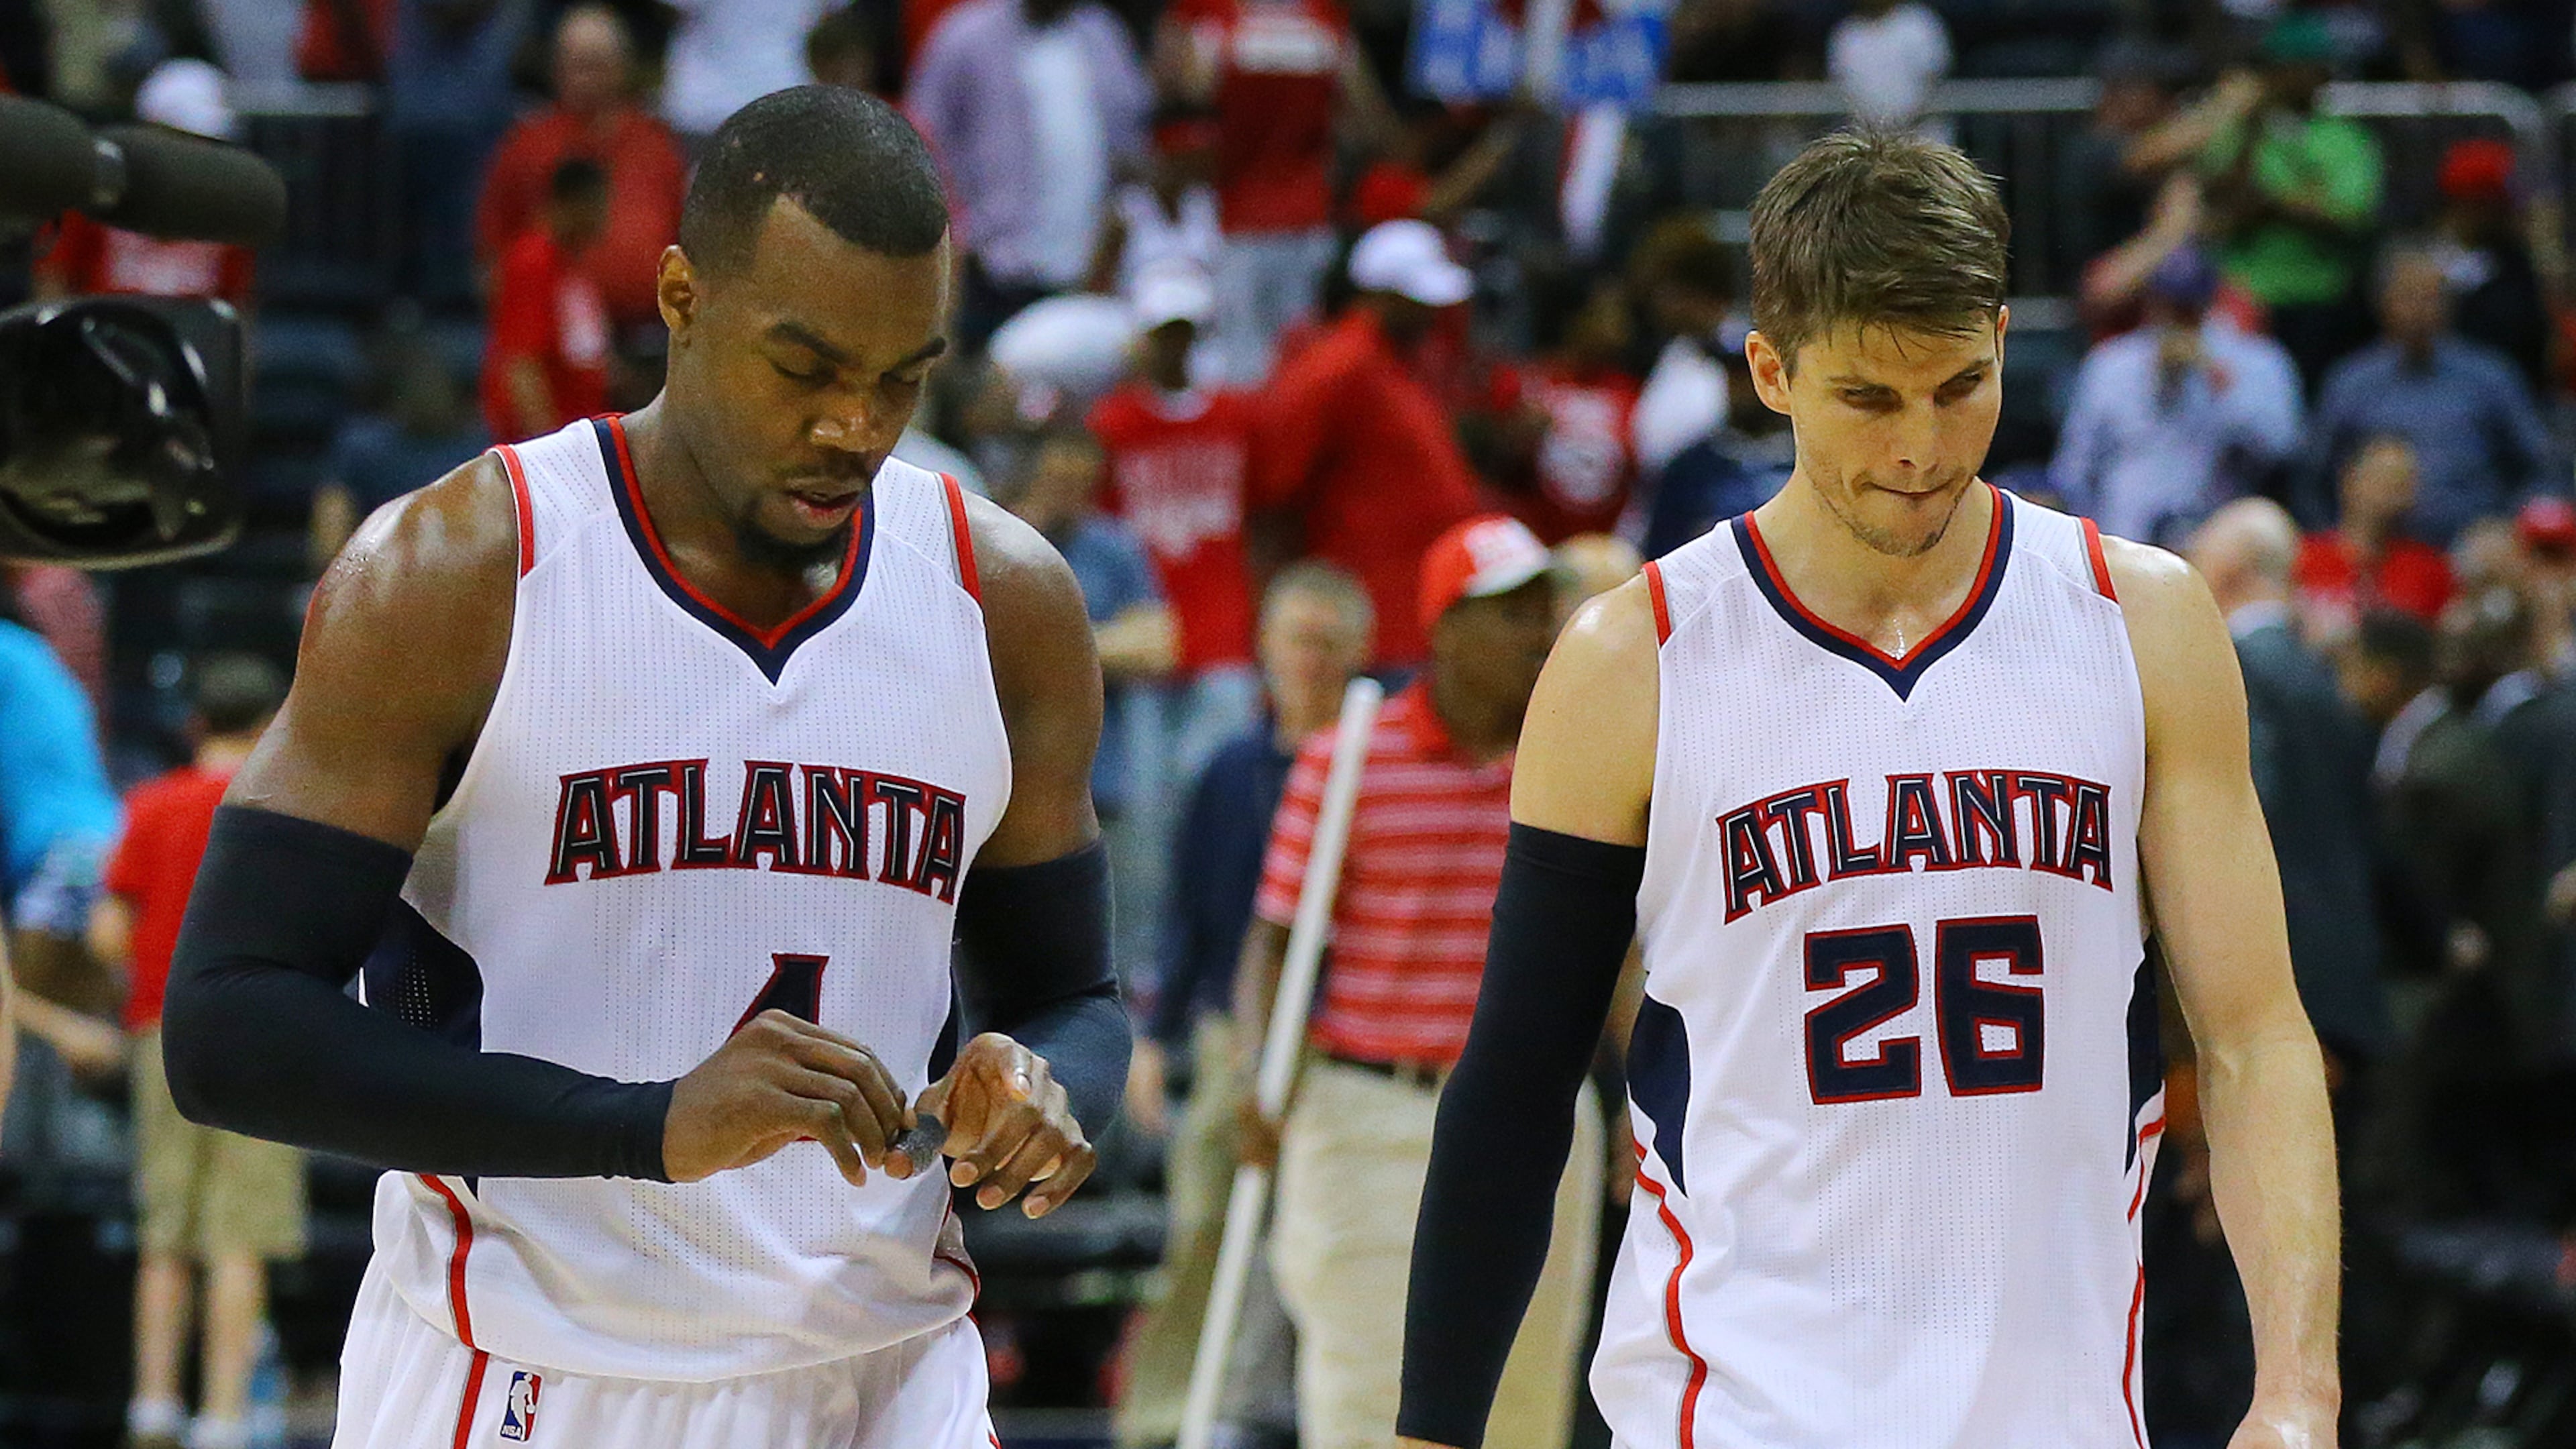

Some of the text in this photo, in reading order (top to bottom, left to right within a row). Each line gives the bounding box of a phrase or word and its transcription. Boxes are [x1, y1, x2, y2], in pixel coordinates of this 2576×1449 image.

[544, 758, 966, 905] ATLANTA
[1716, 769, 2113, 924] ATLANTA
[1805, 915, 2044, 1104] 26
[502, 1425, 522, 1438] NBA
